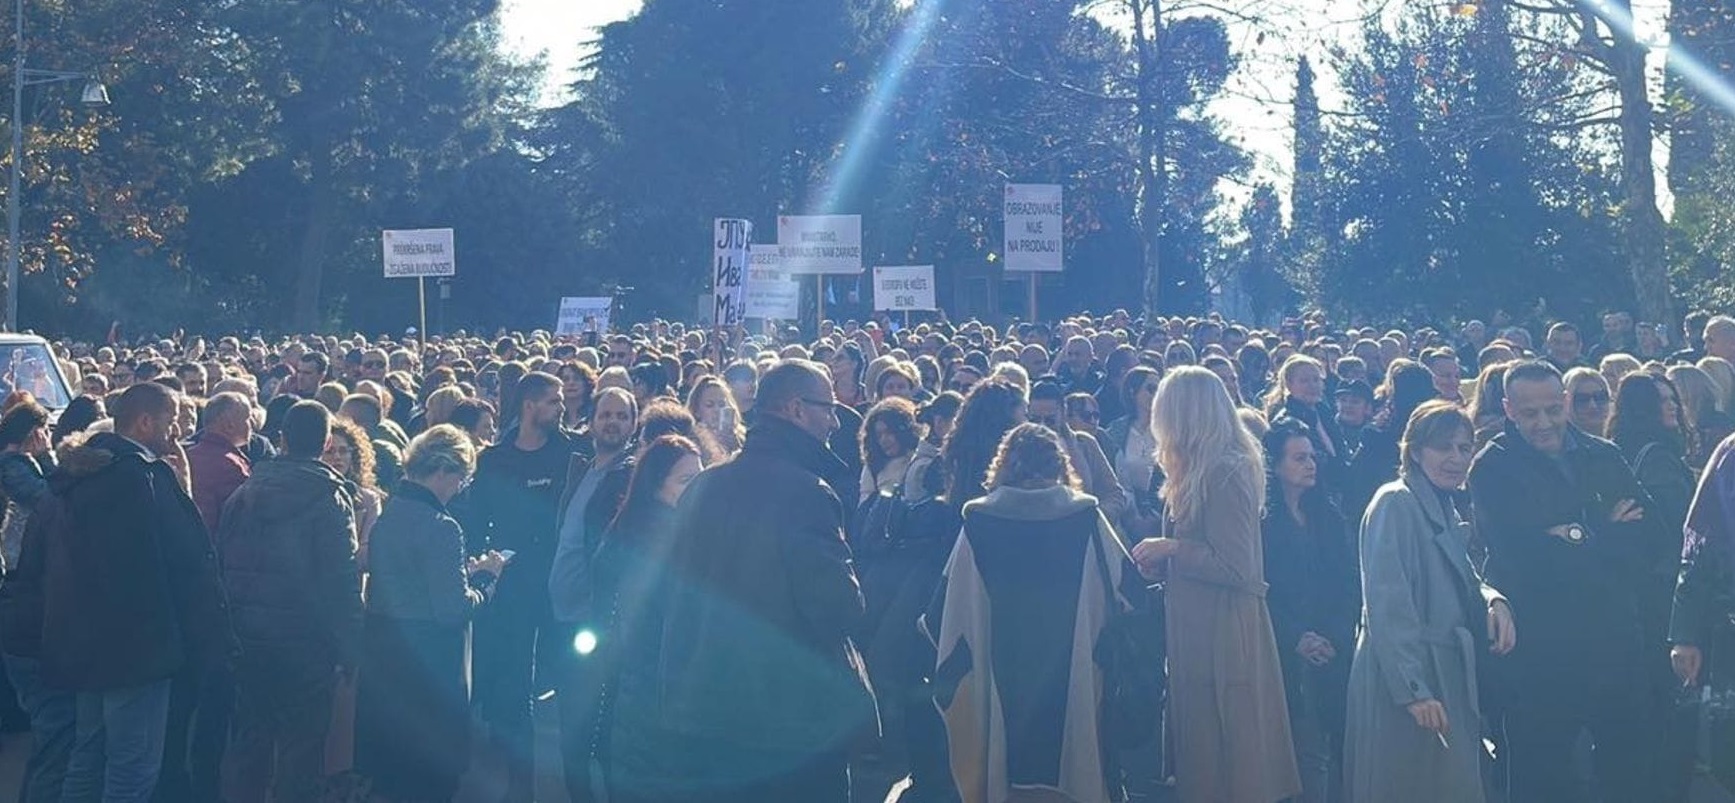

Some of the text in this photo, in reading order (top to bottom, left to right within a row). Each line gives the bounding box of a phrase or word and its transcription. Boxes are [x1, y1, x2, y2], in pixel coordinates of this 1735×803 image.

[1006, 202, 1062, 215] OBRAZOVANJE
[1026, 221, 1043, 234] NIJE
[1007, 240, 1019, 253] NA
[1020, 240, 1056, 253] PRODAJU
